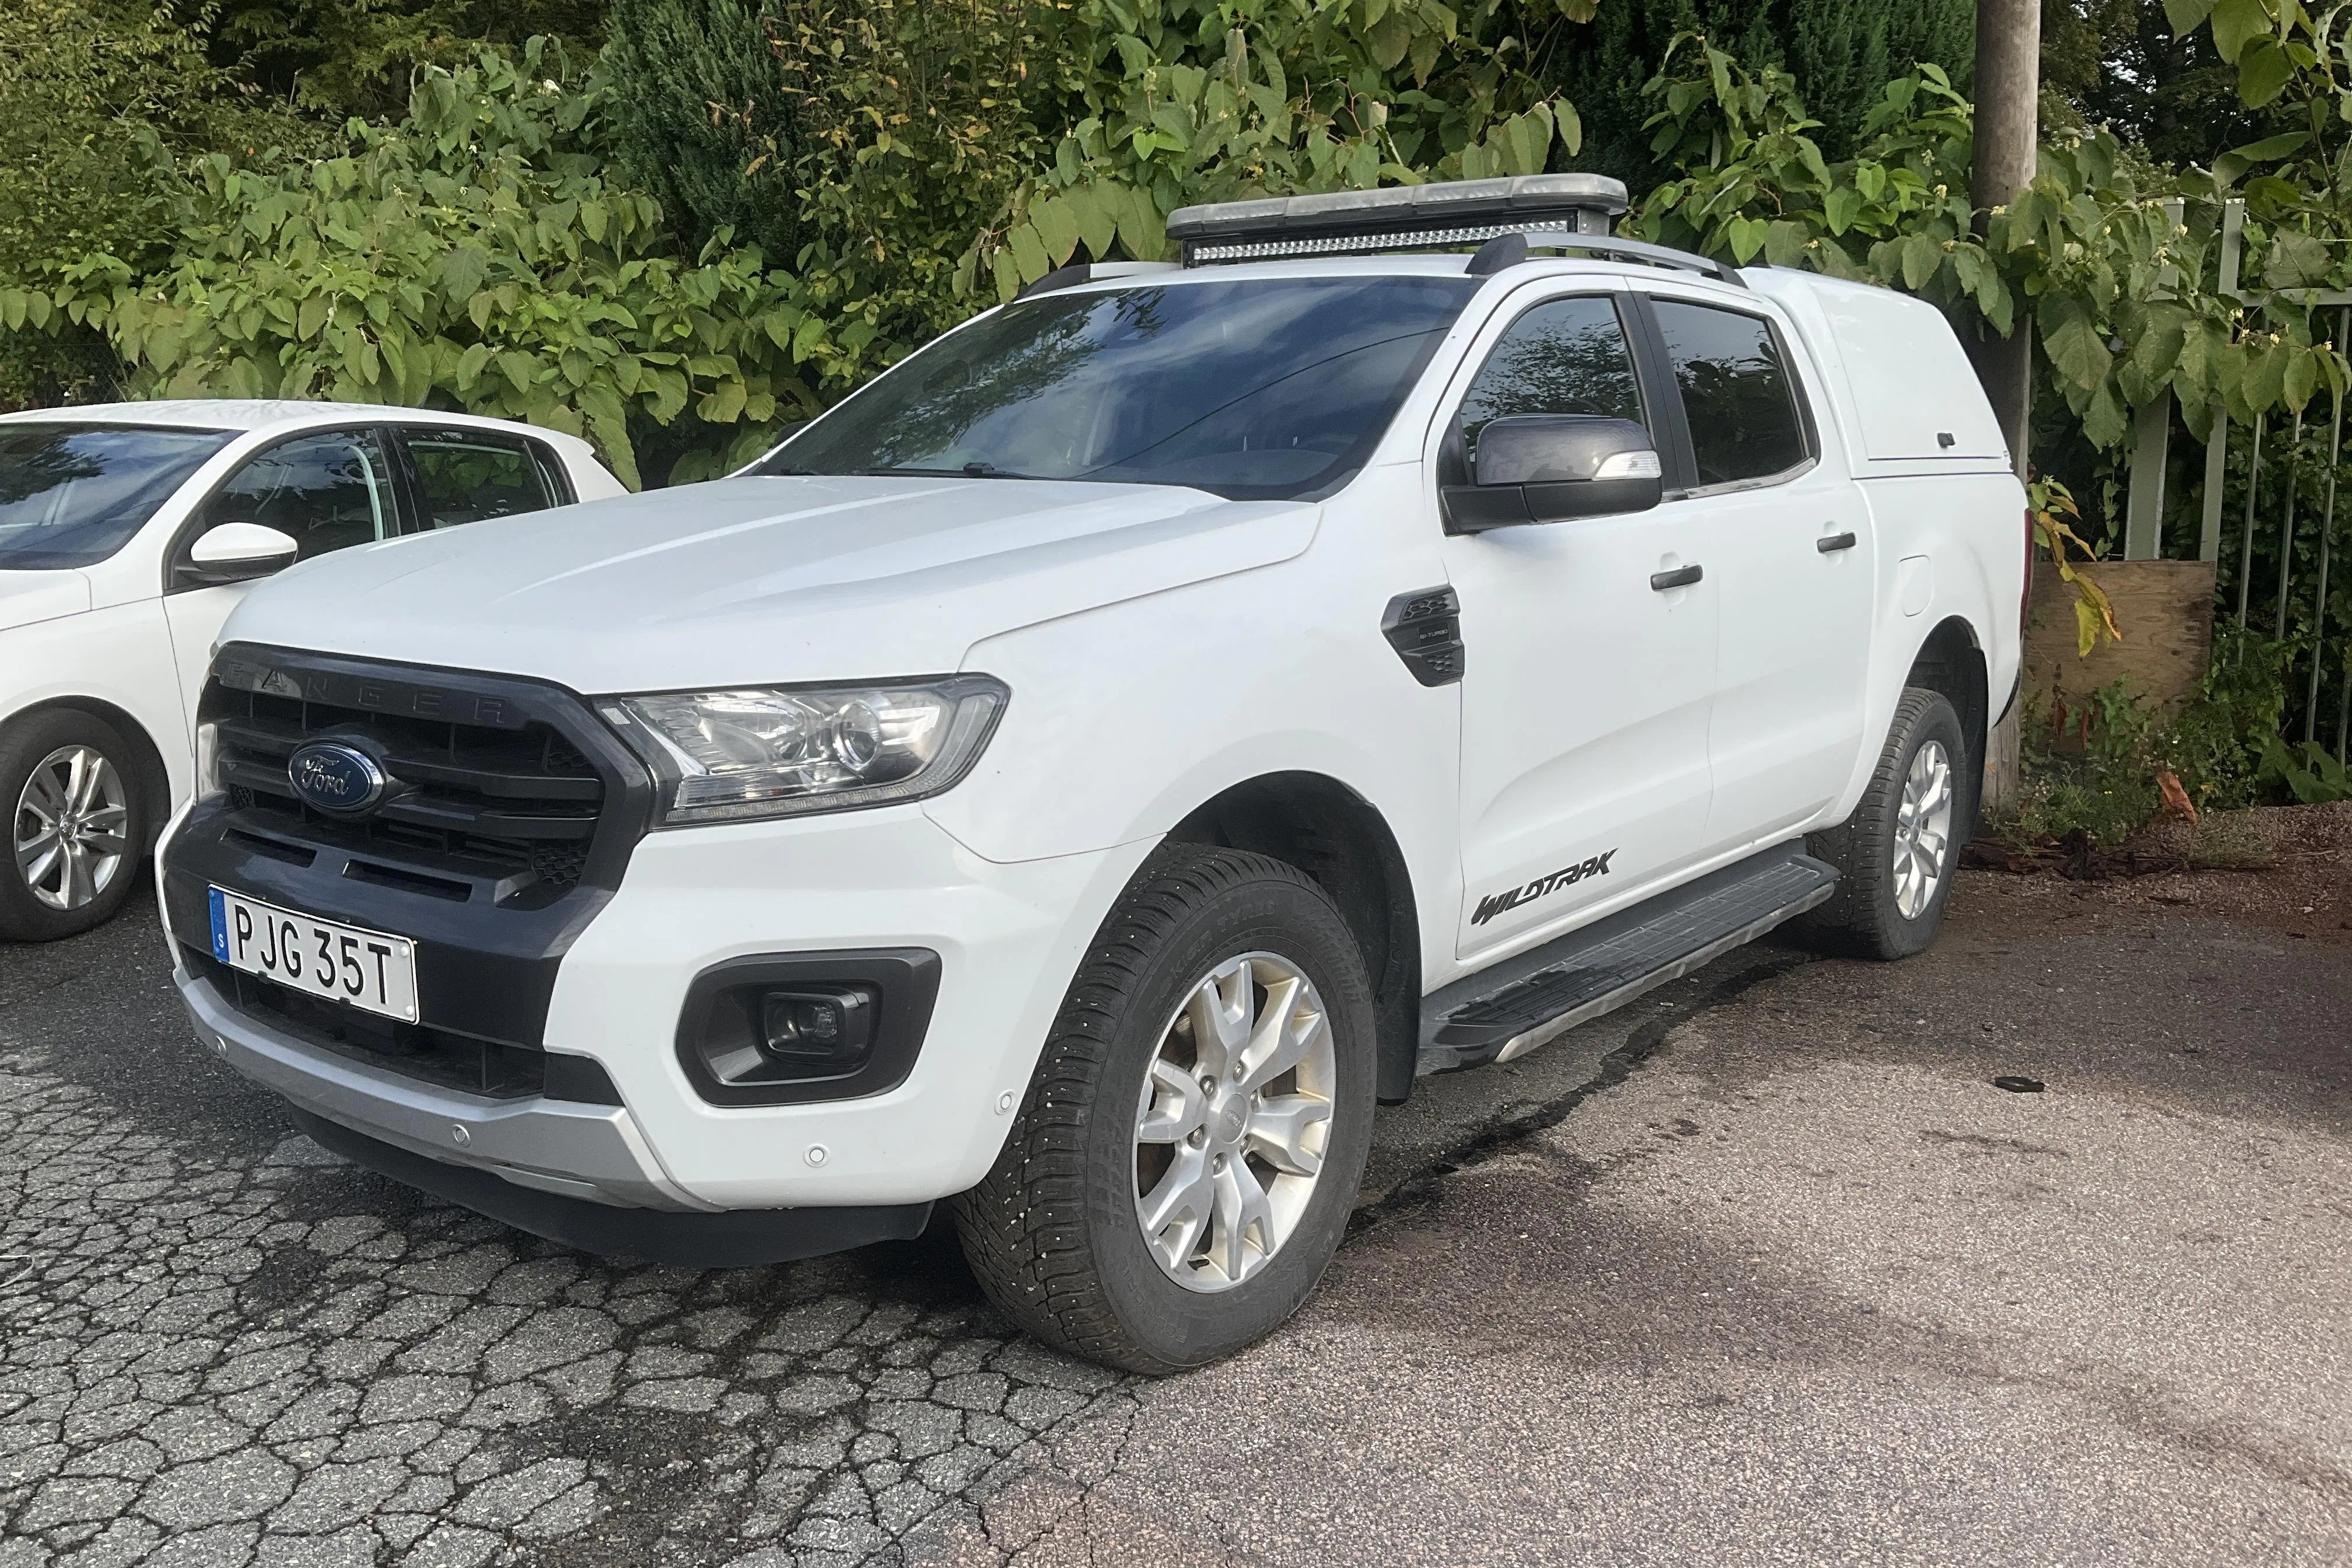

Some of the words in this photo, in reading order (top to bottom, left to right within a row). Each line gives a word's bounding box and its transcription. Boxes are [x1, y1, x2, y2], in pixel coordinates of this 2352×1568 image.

[229, 661, 508, 723] RANGER
[301, 754, 351, 796] Ford
[1471, 848, 1619, 926] WILDTRAK
[218, 933, 224, 949] S
[235, 904, 302, 978] PJG
[313, 928, 391, 1005] 35T
